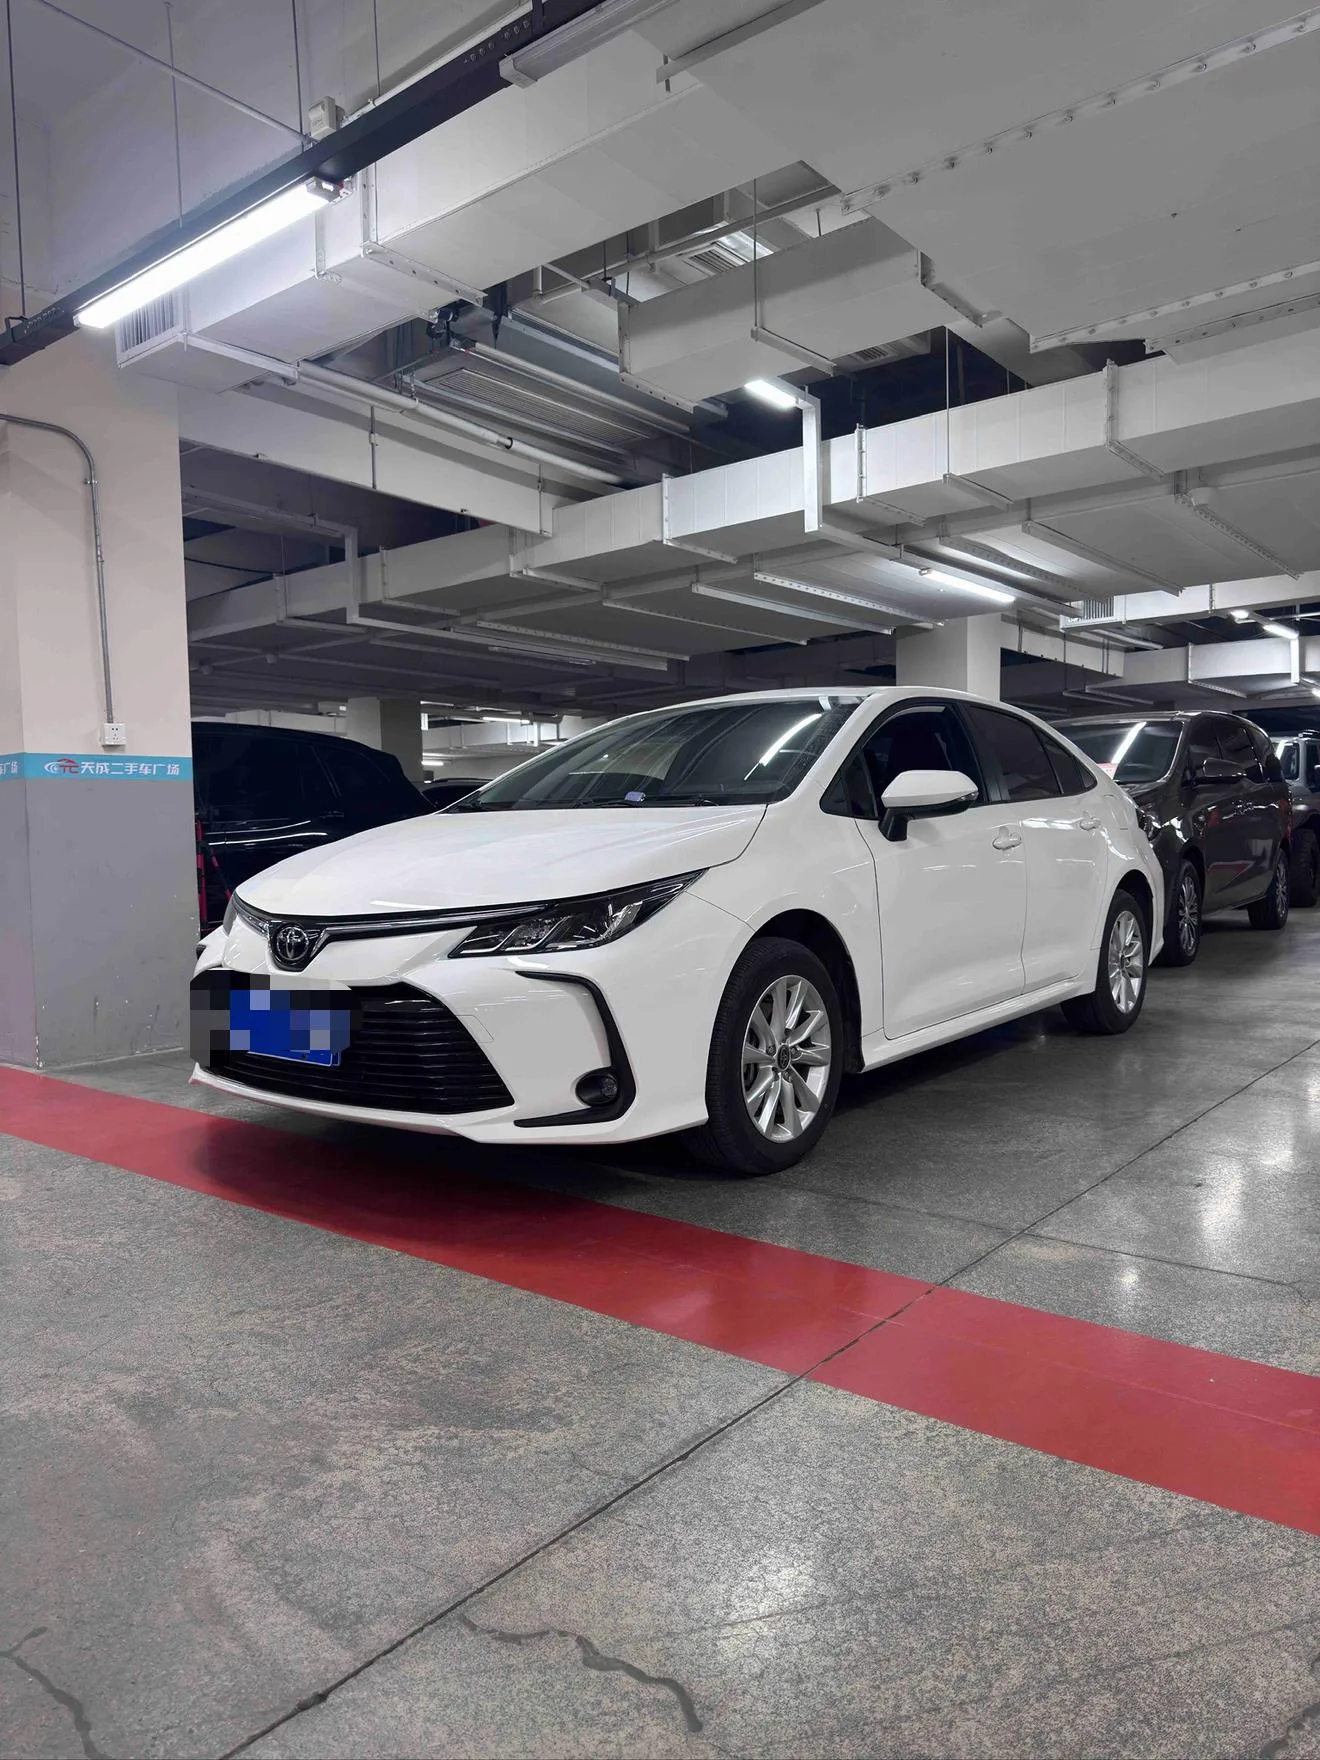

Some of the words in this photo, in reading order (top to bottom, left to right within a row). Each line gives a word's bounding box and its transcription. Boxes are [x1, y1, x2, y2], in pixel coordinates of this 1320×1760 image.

[80, 761, 180, 776] 天成二手车广场
